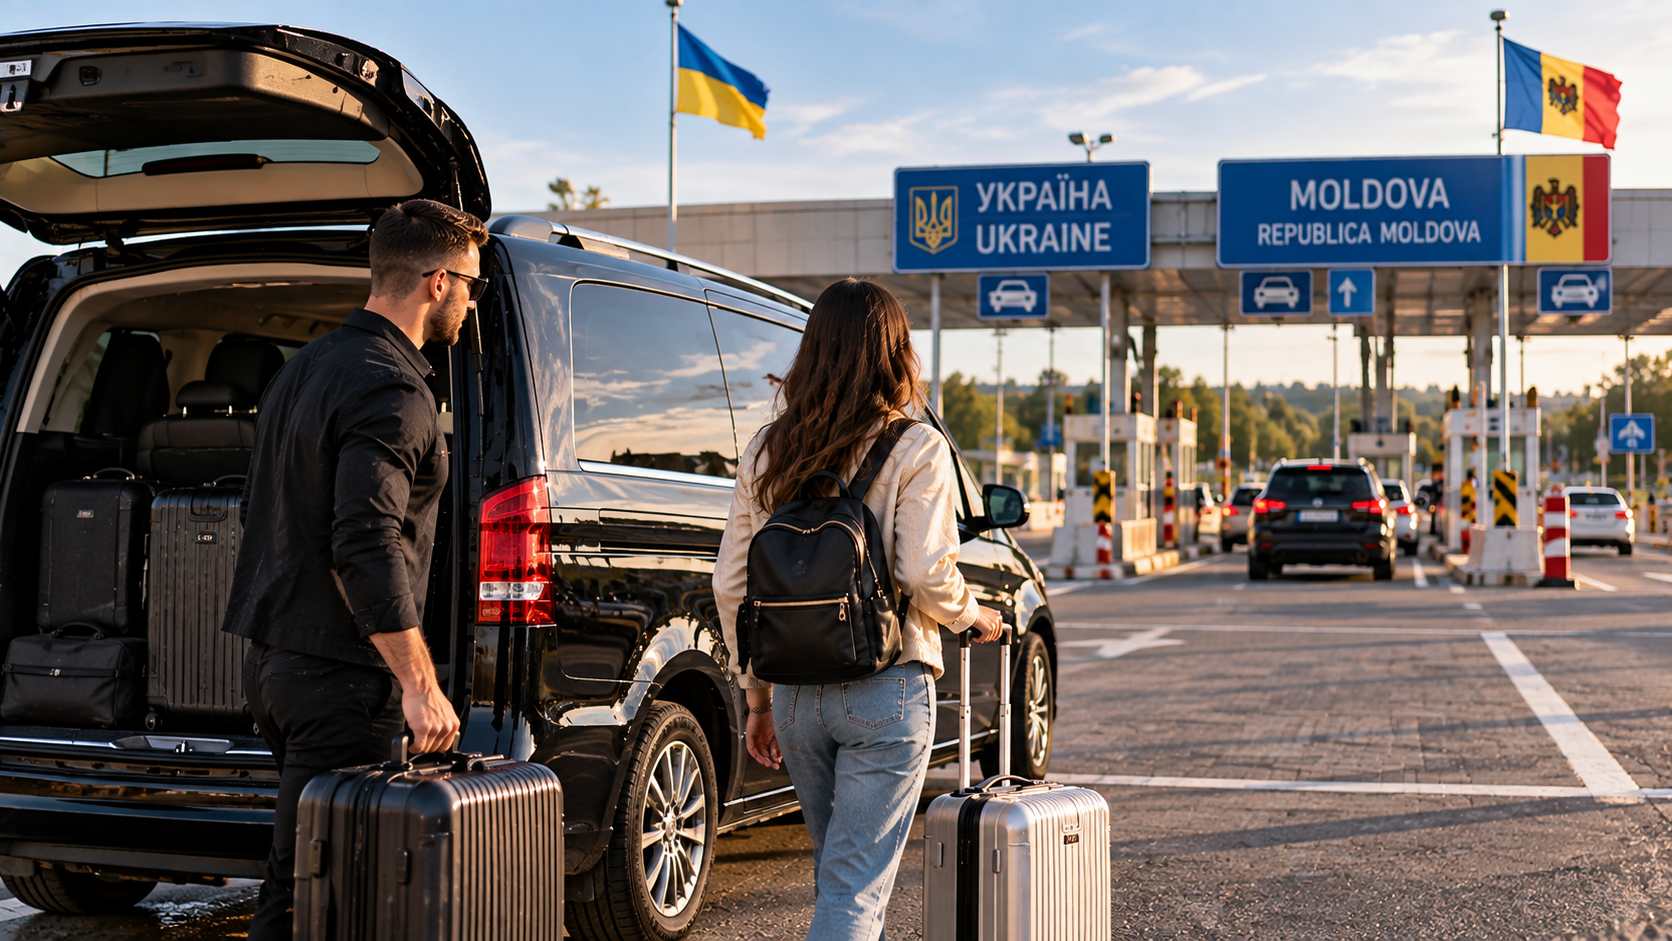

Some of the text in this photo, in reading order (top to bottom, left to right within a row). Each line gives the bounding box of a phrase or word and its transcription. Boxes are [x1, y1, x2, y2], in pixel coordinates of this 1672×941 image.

[976, 173, 1113, 213] УКРАЇНА
[1290, 177, 1450, 211] MOLDOVA
[976, 222, 1112, 255] UKRAINE
[1258, 219, 1482, 246] REPUBLICA MOLDOVA
